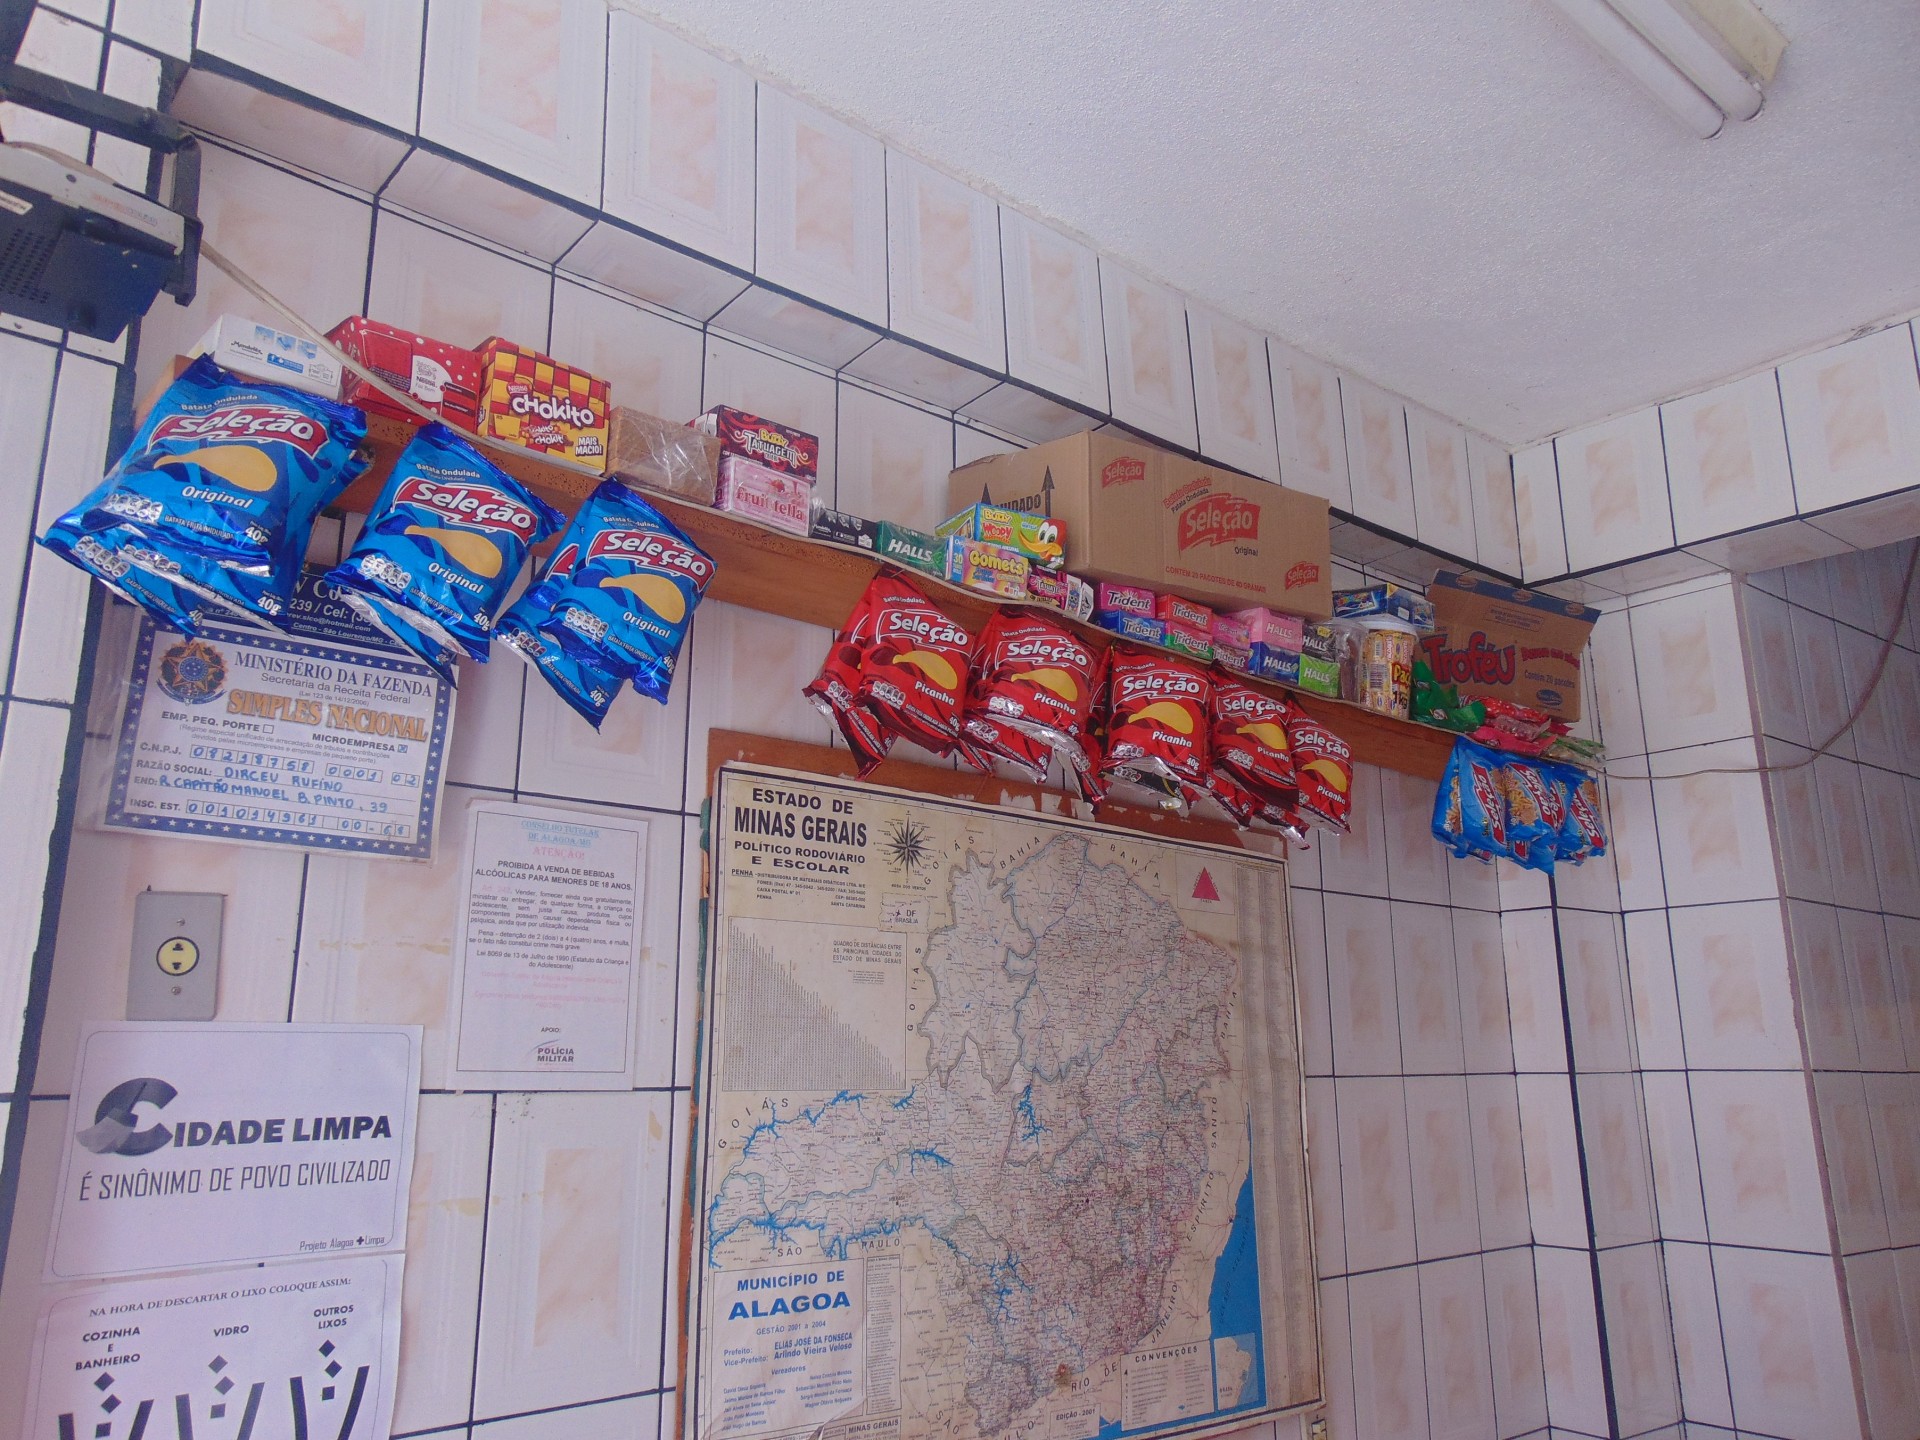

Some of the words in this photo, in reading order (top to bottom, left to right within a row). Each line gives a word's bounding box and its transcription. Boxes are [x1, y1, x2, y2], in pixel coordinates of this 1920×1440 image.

[181, 402, 212, 411] Batata
[214, 394, 258, 406] Ondulada
[169, 409, 314, 441] Seleção
[575, 446, 603, 456] MACIO!
[578, 437, 598, 446] MAIS
[743, 430, 798, 468] TATUAGEM
[416, 463, 440, 475] Batata
[442, 468, 480, 479] Ondulada
[1104, 460, 1142, 482] Seleção
[182, 485, 254, 510] Original
[413, 482, 531, 529] Seleção
[1186, 503, 1252, 538] Seleção
[244, 526, 269, 545] 40g
[604, 532, 706, 576] Seleção
[887, 538, 932, 561] HALLS
[1234, 546, 1258, 557] Original
[970, 550, 1024, 576] Gomets
[428, 562, 485, 594] Original
[1287, 564, 1316, 584] Seleção
[258, 594, 282, 616] 40g
[1108, 590, 1152, 610] Trident
[473, 611, 490, 631] 40g
[622, 610, 671, 638] Original
[1173, 602, 1208, 626] Trident
[293, 622, 318, 632] Centro
[323, 627, 338, 635] São
[889, 612, 968, 646] Seleção
[1123, 618, 1162, 639] Trident
[1266, 622, 1293, 639] HALLS
[1174, 630, 1209, 652] Trident
[1303, 636, 1328, 652] HALLS
[1007, 640, 1087, 666] Seleção
[1212, 646, 1246, 668] Trident
[234, 650, 334, 682] MINISTÉRIO
[337, 668, 358, 685] DA
[362, 672, 432, 698] FAZENDA
[1264, 656, 1292, 672] HALLS
[1304, 668, 1330, 682] HALLS
[261, 672, 316, 691] Secretaria
[317, 680, 330, 692] da
[334, 682, 372, 698] Receita
[374, 688, 411, 704] Federal
[914, 680, 955, 706] Picanha
[1122, 676, 1200, 696] Seleção
[1034, 692, 1076, 716] Picanha
[1222, 696, 1286, 715] Seleção
[162, 710, 189, 723] EMP.
[192, 716, 219, 728] PEQ.
[222, 720, 260, 732] PORTE
[227, 688, 322, 726] SIMPLES
[327, 704, 430, 742] NACIONAL
[312, 732, 396, 752] MICROEMPRESA
[1152, 730, 1192, 748] Picanha
[1294, 730, 1350, 759] Seleção
[1258, 746, 1290, 763] Picanha
[136, 759, 171, 772] RAZÃO
[174, 764, 212, 776] SOCIAL:
[224, 767, 279, 784] DIRCEU
[134, 776, 158, 786] END:
[231, 785, 290, 802] MANOEL
[370, 802, 388, 812] 39
[752, 788, 822, 810] ESTADO
[832, 800, 854, 815] DE
[1316, 784, 1346, 805] Picanha
[1478, 774, 1502, 831] Seleção
[521, 820, 562, 832] CONSELHO
[734, 806, 796, 839] MINAS
[801, 816, 868, 848] GERAIS
[734, 839, 792, 856] POLÍTICO
[795, 846, 866, 864] RODOVIÁRIO
[999, 836, 1041, 869] BAHIA
[498, 860, 534, 871] PROIBIDA
[537, 864, 542, 872] A
[544, 866, 570, 874] VENDA
[572, 868, 582, 876] DE
[584, 870, 615, 879] BEBIDAS
[752, 856, 762, 866] E
[773, 858, 850, 876] ESCOLAR
[476, 868, 526, 880] ALCÓOLICAS
[528, 874, 549, 882] PARA
[551, 876, 588, 886] MENORES
[590, 880, 600, 888] DE
[611, 882, 632, 892] ANOS.
[894, 916, 918, 924] BRASÍLIA
[833, 940, 853, 948] QUADRO
[860, 941, 887, 950] DISTÂNCIAS
[538, 1048, 574, 1056] POLÍCIA
[292, 1115, 392, 1142] LIMPA
[80, 1171, 92, 1201] É
[98, 1168, 200, 1200] SINÔNIMO
[209, 1168, 234, 1192] DE
[241, 1164, 291, 1190] POVO
[297, 1159, 391, 1186] CIVILIZADO
[300, 1240, 328, 1252] Projeto
[330, 1238, 354, 1249] Alagoa
[777, 1246, 803, 1258] SÃO
[861, 1238, 901, 1250] PAULO
[737, 1272, 818, 1292] MUNICÍPIO
[826, 1270, 845, 1283] DE
[89, 1307, 106, 1318] NA
[110, 1303, 144, 1316] HORA
[148, 1300, 162, 1310] DE
[164, 1292, 228, 1309] DESCARTAR
[230, 1290, 240, 1300] O
[242, 1287, 266, 1298] LIXO
[269, 1280, 318, 1296] COLOQUE
[318, 1276, 352, 1290] ASSIM:
[728, 1291, 851, 1321] ALAGOA
[313, 1304, 354, 1318] OUTROS
[82, 1326, 140, 1343] COZINHA
[213, 1324, 250, 1338] VIDRO
[318, 1318, 348, 1330] LIXOS
[756, 1324, 785, 1336] GESTÃO
[788, 1322, 801, 1332] 2001
[812, 1320, 827, 1328] 2004
[107, 1343, 114, 1354] E
[724, 1347, 753, 1356] Prefeito:
[774, 1340, 793, 1350] ELIAS
[794, 1338, 812, 1347] JOSÉ
[814, 1336, 824, 1345] DA
[824, 1332, 852, 1344] FONSECA
[724, 1356, 769, 1367] Vice-Prefeito:
[774, 1350, 801, 1360] Arlindo
[804, 1346, 827, 1356] Vieira
[829, 1342, 852, 1352] Veloso
[1135, 1345, 1198, 1364] CONVENÇÕES
[75, 1353, 140, 1372] BANHEIRO
[848, 1422, 872, 1434] MINAS
[872, 1418, 898, 1429] GERAIS
